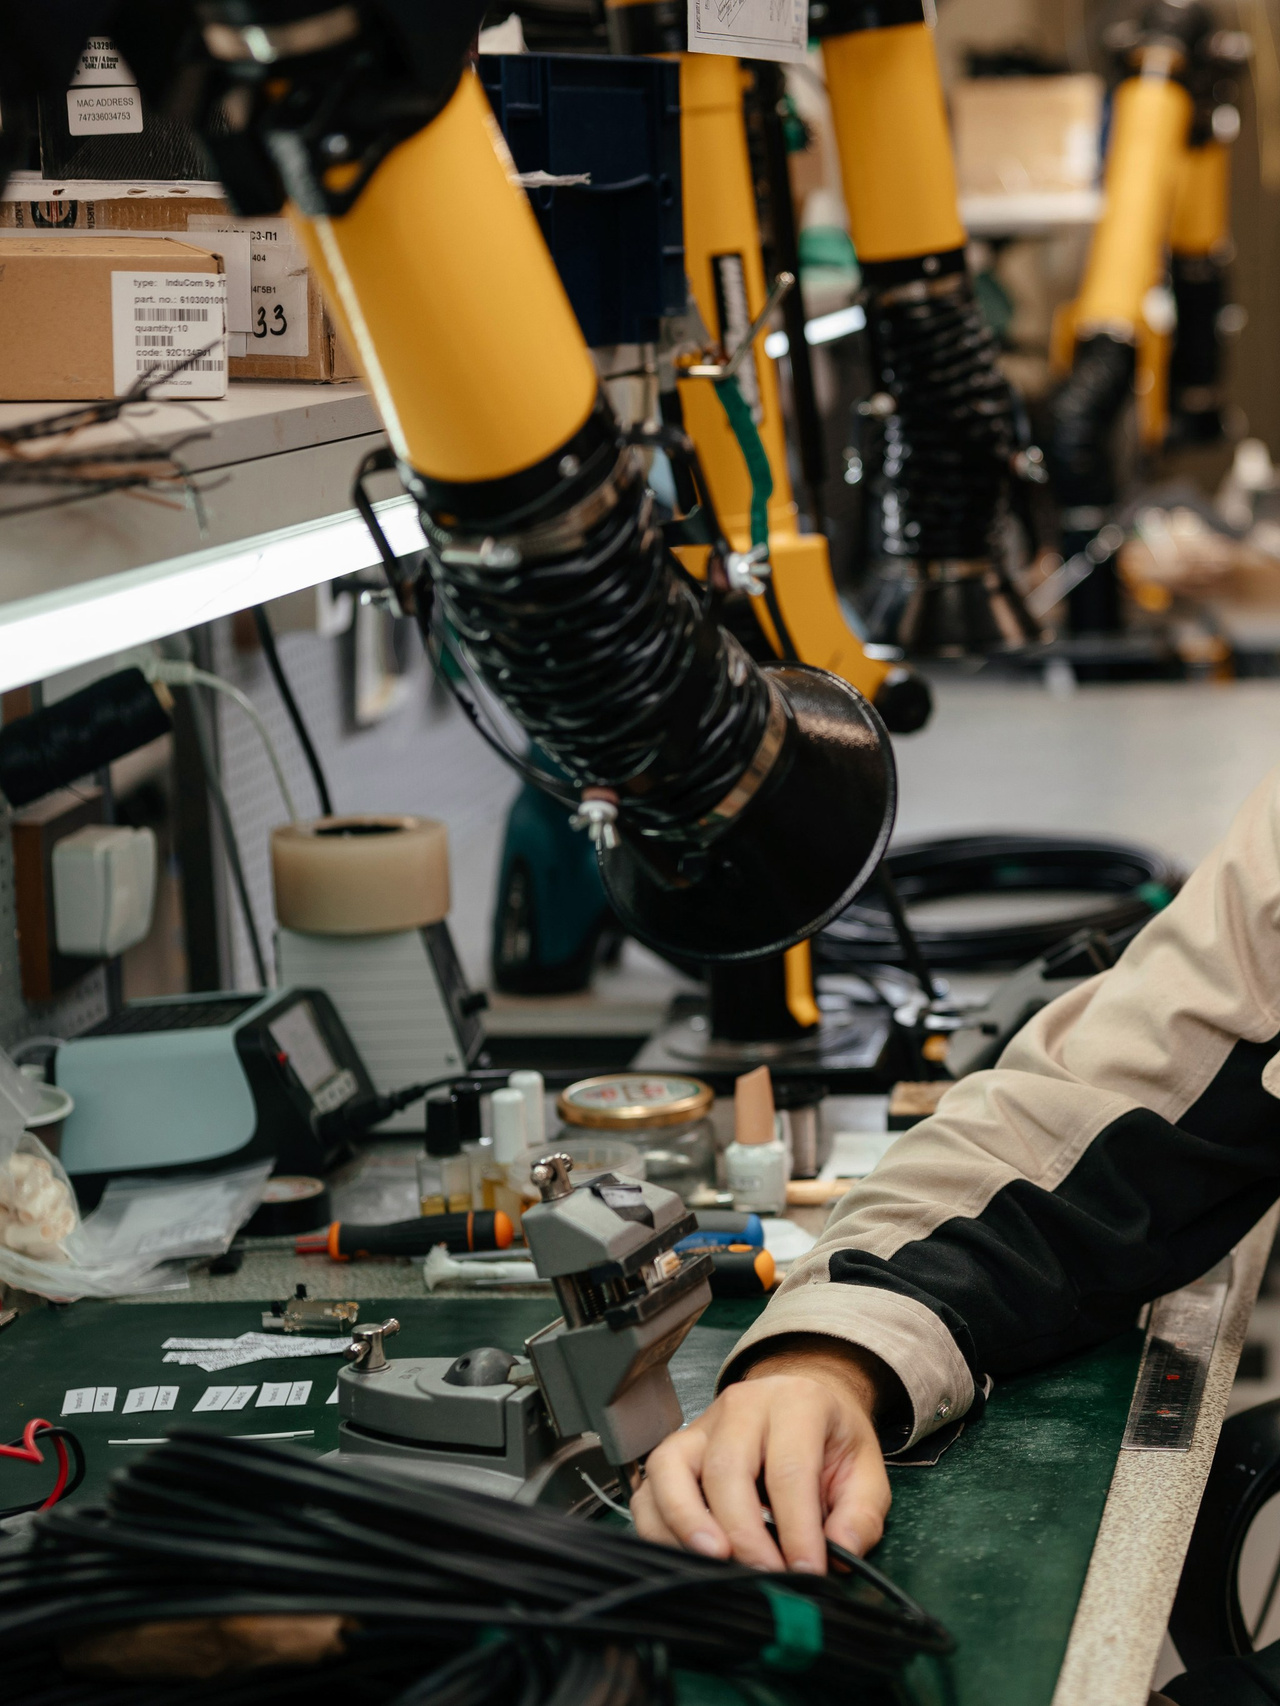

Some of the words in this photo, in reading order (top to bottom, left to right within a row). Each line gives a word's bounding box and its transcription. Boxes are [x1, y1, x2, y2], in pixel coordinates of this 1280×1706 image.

[77, 99, 95, 107] MAC
[96, 98, 134, 106] ADDRESS
[133, 279, 157, 288] type:
[165, 279, 203, 287] InduCom
[136, 349, 163, 357] code:
